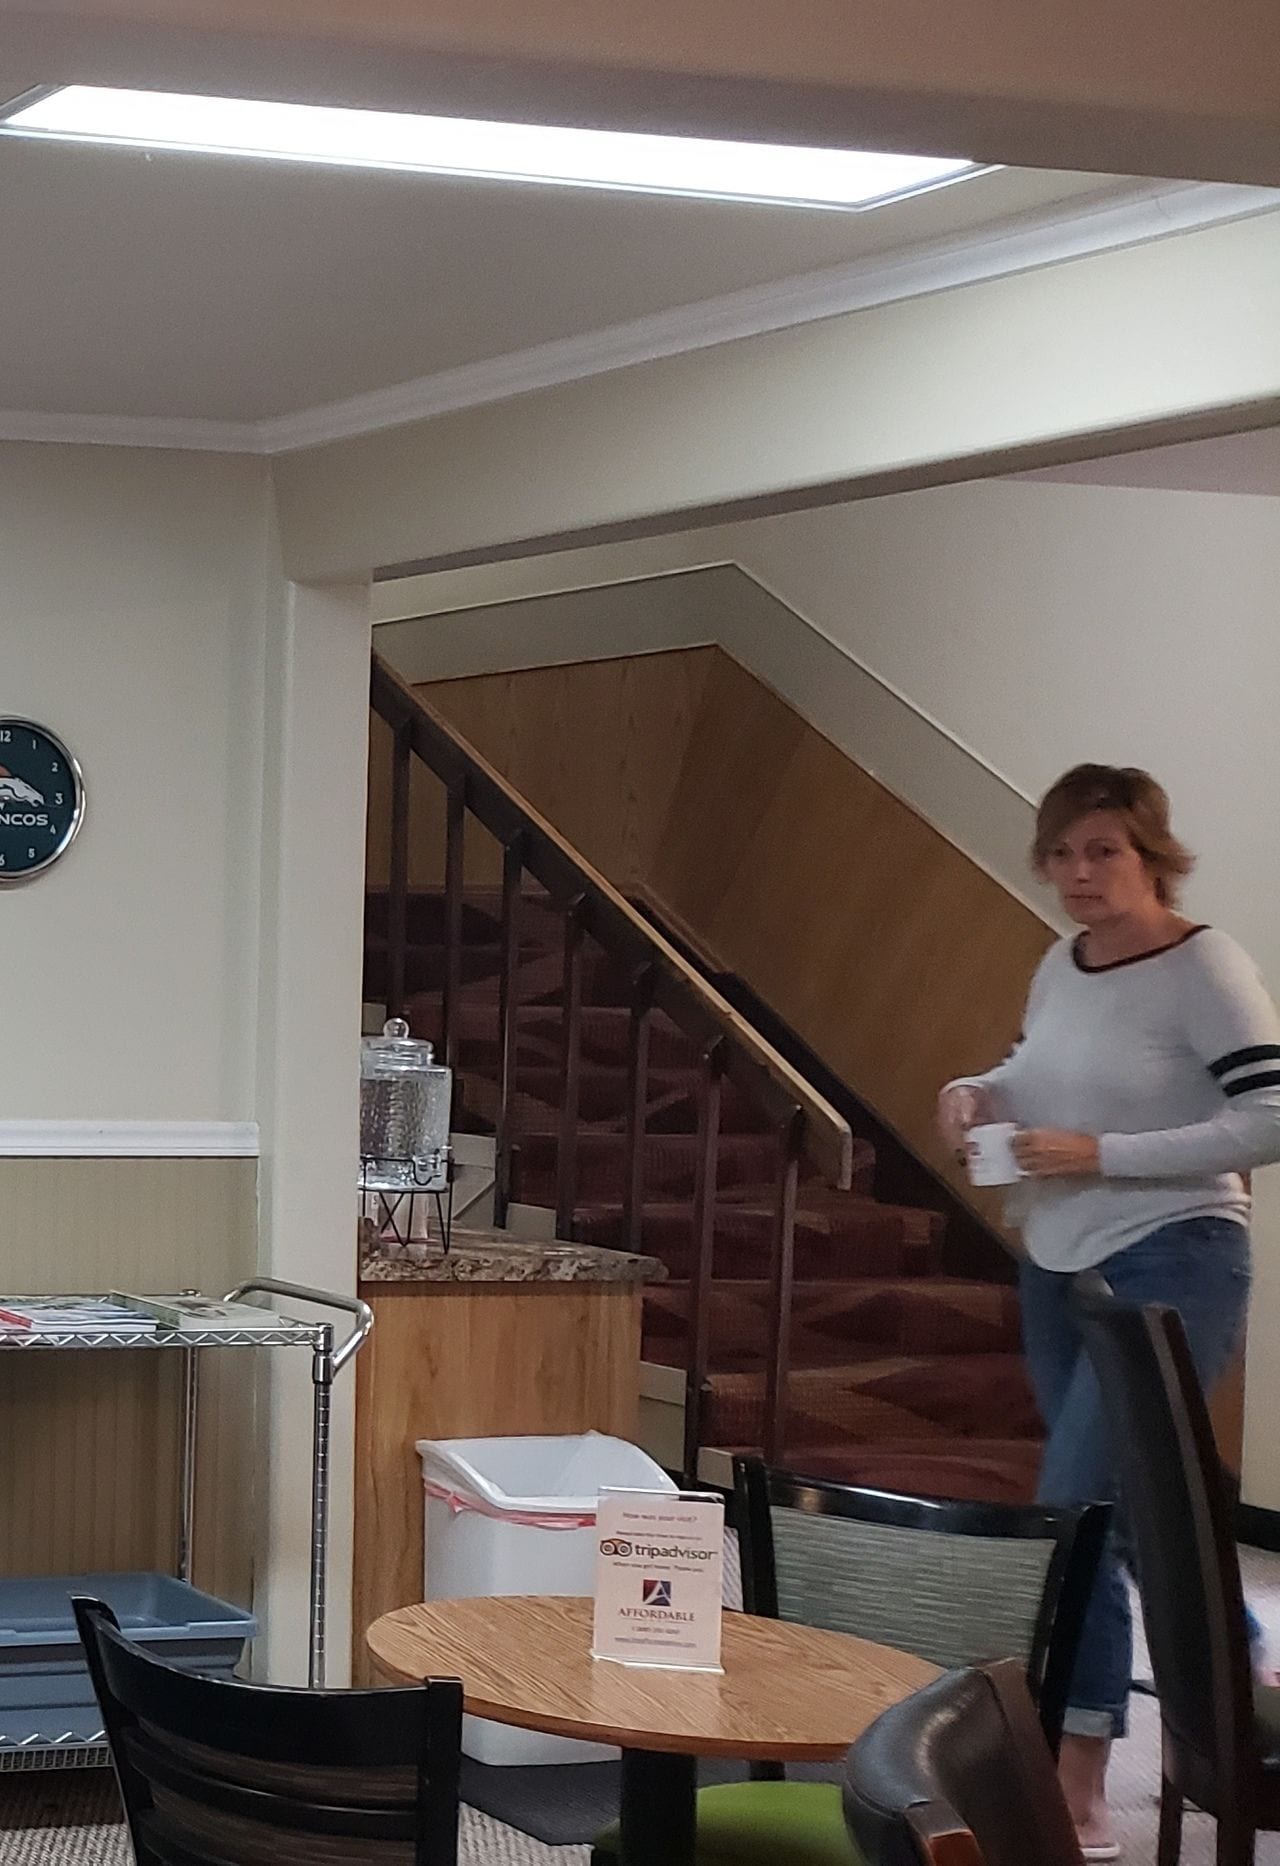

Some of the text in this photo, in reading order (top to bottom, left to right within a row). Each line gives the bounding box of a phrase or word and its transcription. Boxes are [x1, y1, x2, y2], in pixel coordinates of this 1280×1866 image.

[0, 730, 11, 743] 12
[51, 762, 58, 772] 2
[55, 793, 63, 805] 3
[50, 825, 56, 835] 4
[28, 848, 35, 859] 5
[635, 1544, 715, 1560] tripadvisor
[618, 1608, 696, 1621] AFFORDABLE
